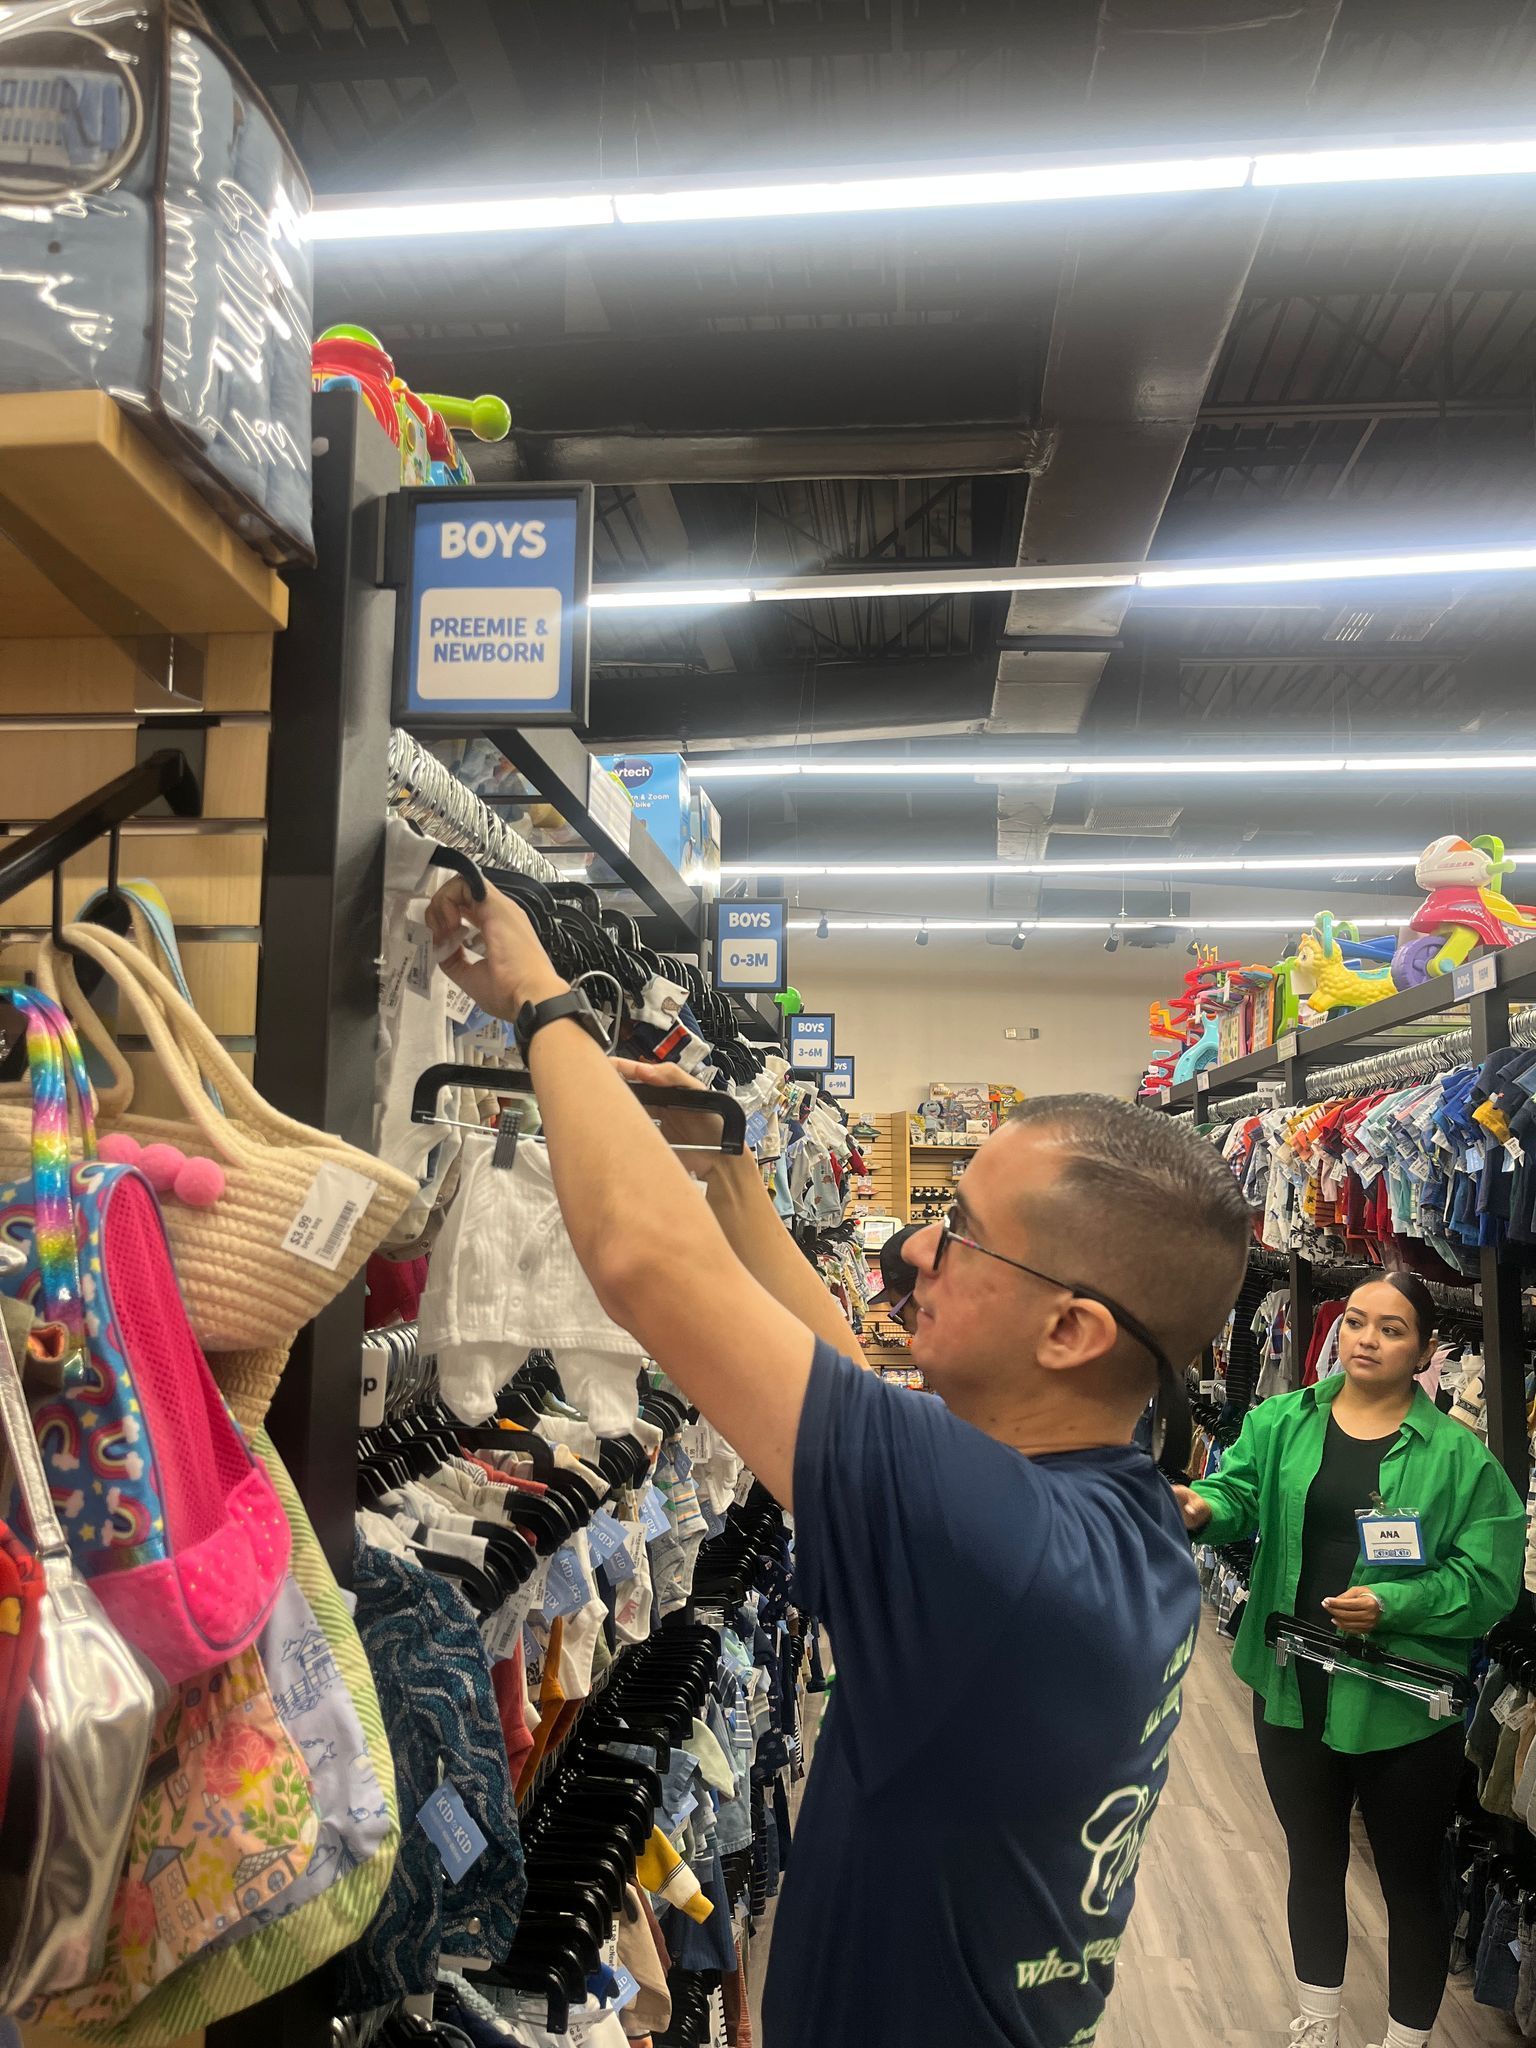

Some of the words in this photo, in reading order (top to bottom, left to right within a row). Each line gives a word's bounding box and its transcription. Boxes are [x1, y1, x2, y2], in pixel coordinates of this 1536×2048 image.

[440, 520, 547, 559] BOYS
[430, 617, 527, 638] PREEMIE
[535, 619, 549, 636] &
[434, 642, 545, 664] NEWBORN
[614, 766, 650, 778] vtech
[728, 912, 771, 928] BOYS
[730, 953, 769, 967] 0-3M
[798, 1022, 825, 1033] BOYS
[798, 1048, 823, 1057] 3-6M
[833, 1062, 848, 1071] OYS
[828, 1080, 847, 1088] 6-9M
[289, 1215, 312, 1246] $3.99
[361, 1377, 378, 1396] p
[1379, 1530, 1400, 1539] ANA
